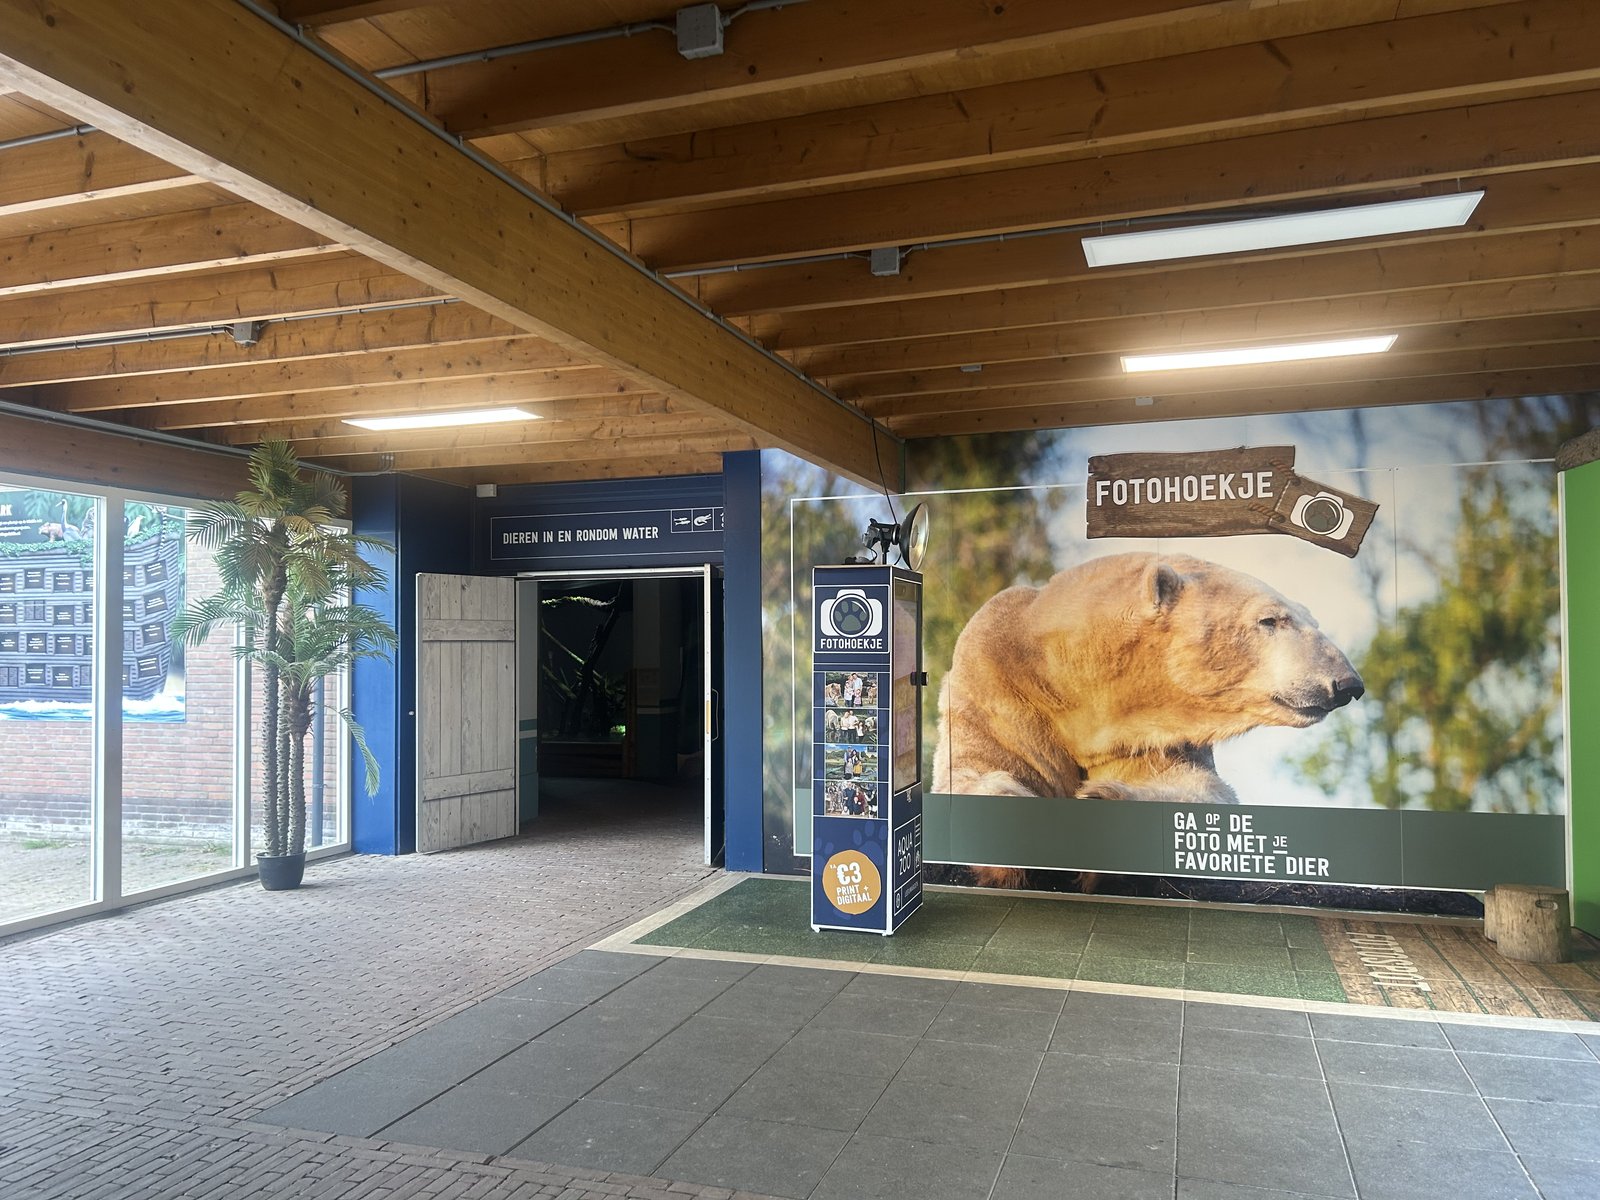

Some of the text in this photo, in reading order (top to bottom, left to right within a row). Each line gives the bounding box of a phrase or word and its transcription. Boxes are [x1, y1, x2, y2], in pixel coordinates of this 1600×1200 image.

[1096, 471, 1273, 506] FOTOHOEKJE
[502, 526, 659, 544] DIEREN IN EN RONDOM WATER
[820, 638, 883, 649] FOTOHOEKJE
[1174, 811, 1253, 833] GA OP DE
[897, 832, 913, 857] AQUA
[1174, 831, 1288, 854] FOTO MET JE
[836, 861, 862, 885] €3
[899, 852, 911, 876] ZOO
[1175, 851, 1329, 877] FAVORIETE DIER
[836, 884, 860, 896] PRINT
[836, 892, 872, 906] DIGITAAL
[1346, 931, 1432, 992] FOTOSPOT
